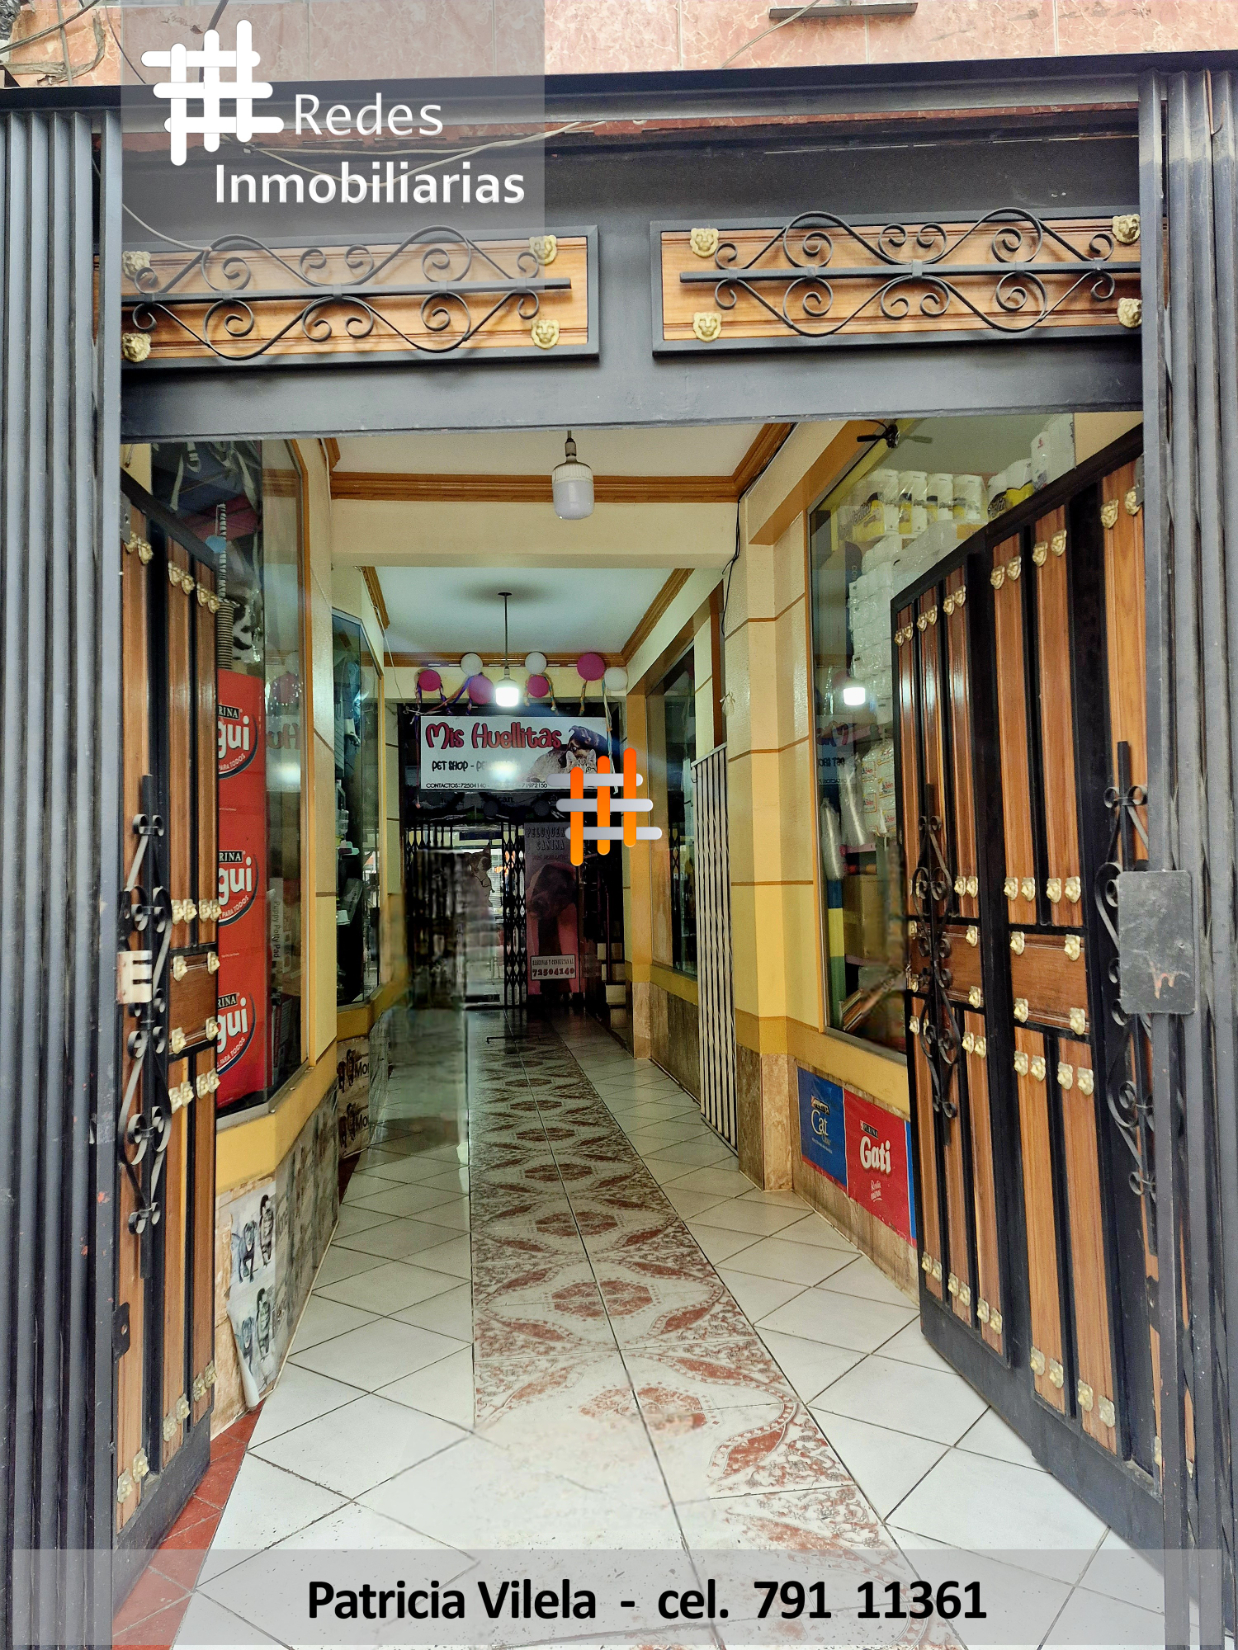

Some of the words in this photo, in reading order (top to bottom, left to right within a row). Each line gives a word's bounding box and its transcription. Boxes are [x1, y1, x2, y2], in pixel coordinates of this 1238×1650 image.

[218, 706, 239, 719] RINA
[218, 715, 250, 760] gui
[426, 722, 465, 750] Mis
[471, 721, 562, 750] Huellitas
[431, 760, 447, 772] PET
[448, 760, 469, 772] SHOP
[218, 852, 242, 862] RINA
[219, 856, 252, 906] gui
[273, 944, 281, 958] Pad
[532, 967, 575, 977] 72504140
[217, 995, 237, 1008] RINA
[217, 997, 249, 1054] gui
[811, 1109, 829, 1137] Cat
[860, 1136, 892, 1174] Gati
